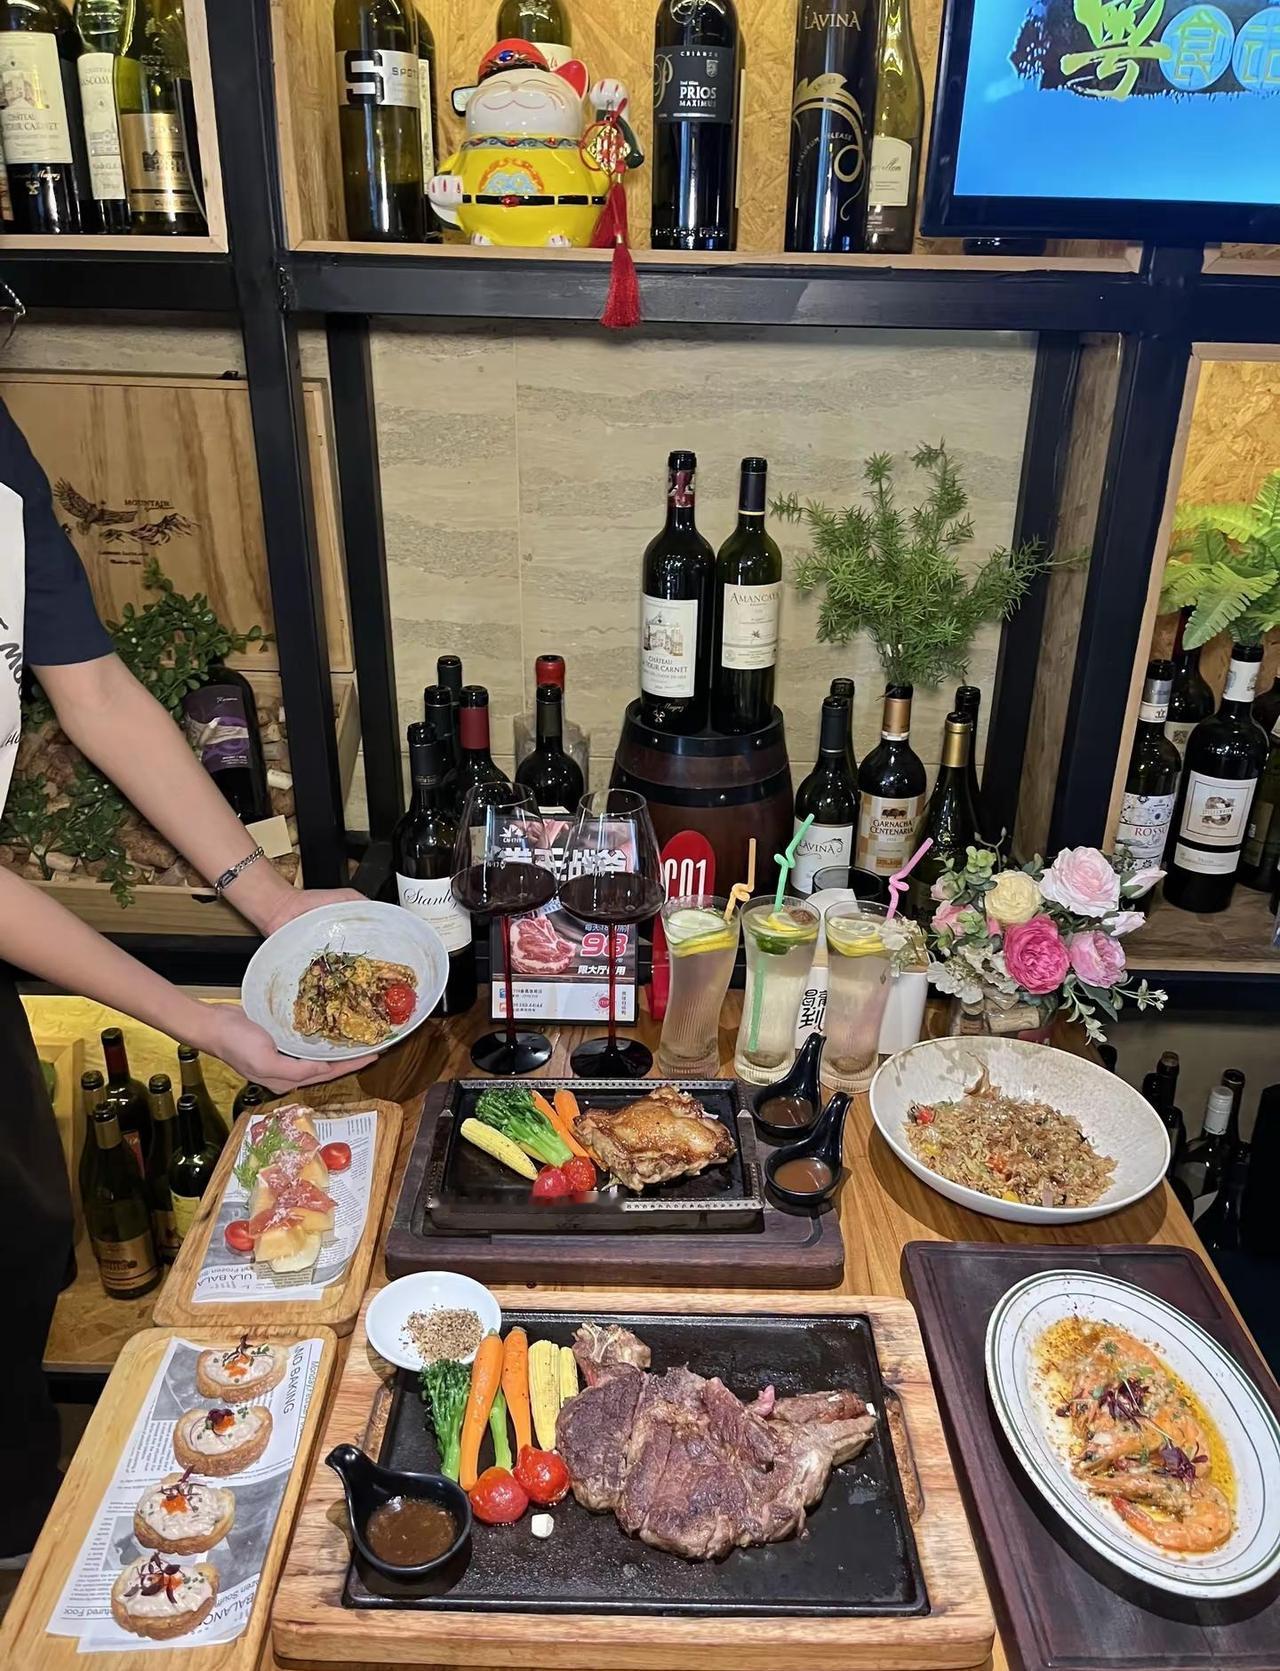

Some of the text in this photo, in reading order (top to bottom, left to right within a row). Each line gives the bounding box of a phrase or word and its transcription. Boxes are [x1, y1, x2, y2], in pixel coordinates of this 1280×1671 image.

[804, 10, 861, 31] LAVINA
[679, 86, 717, 99] PRIOS
[580, 932, 628, 957] 98
[578, 965, 626, 976] 限大厅用
[283, 1367, 301, 1414] BAKING
